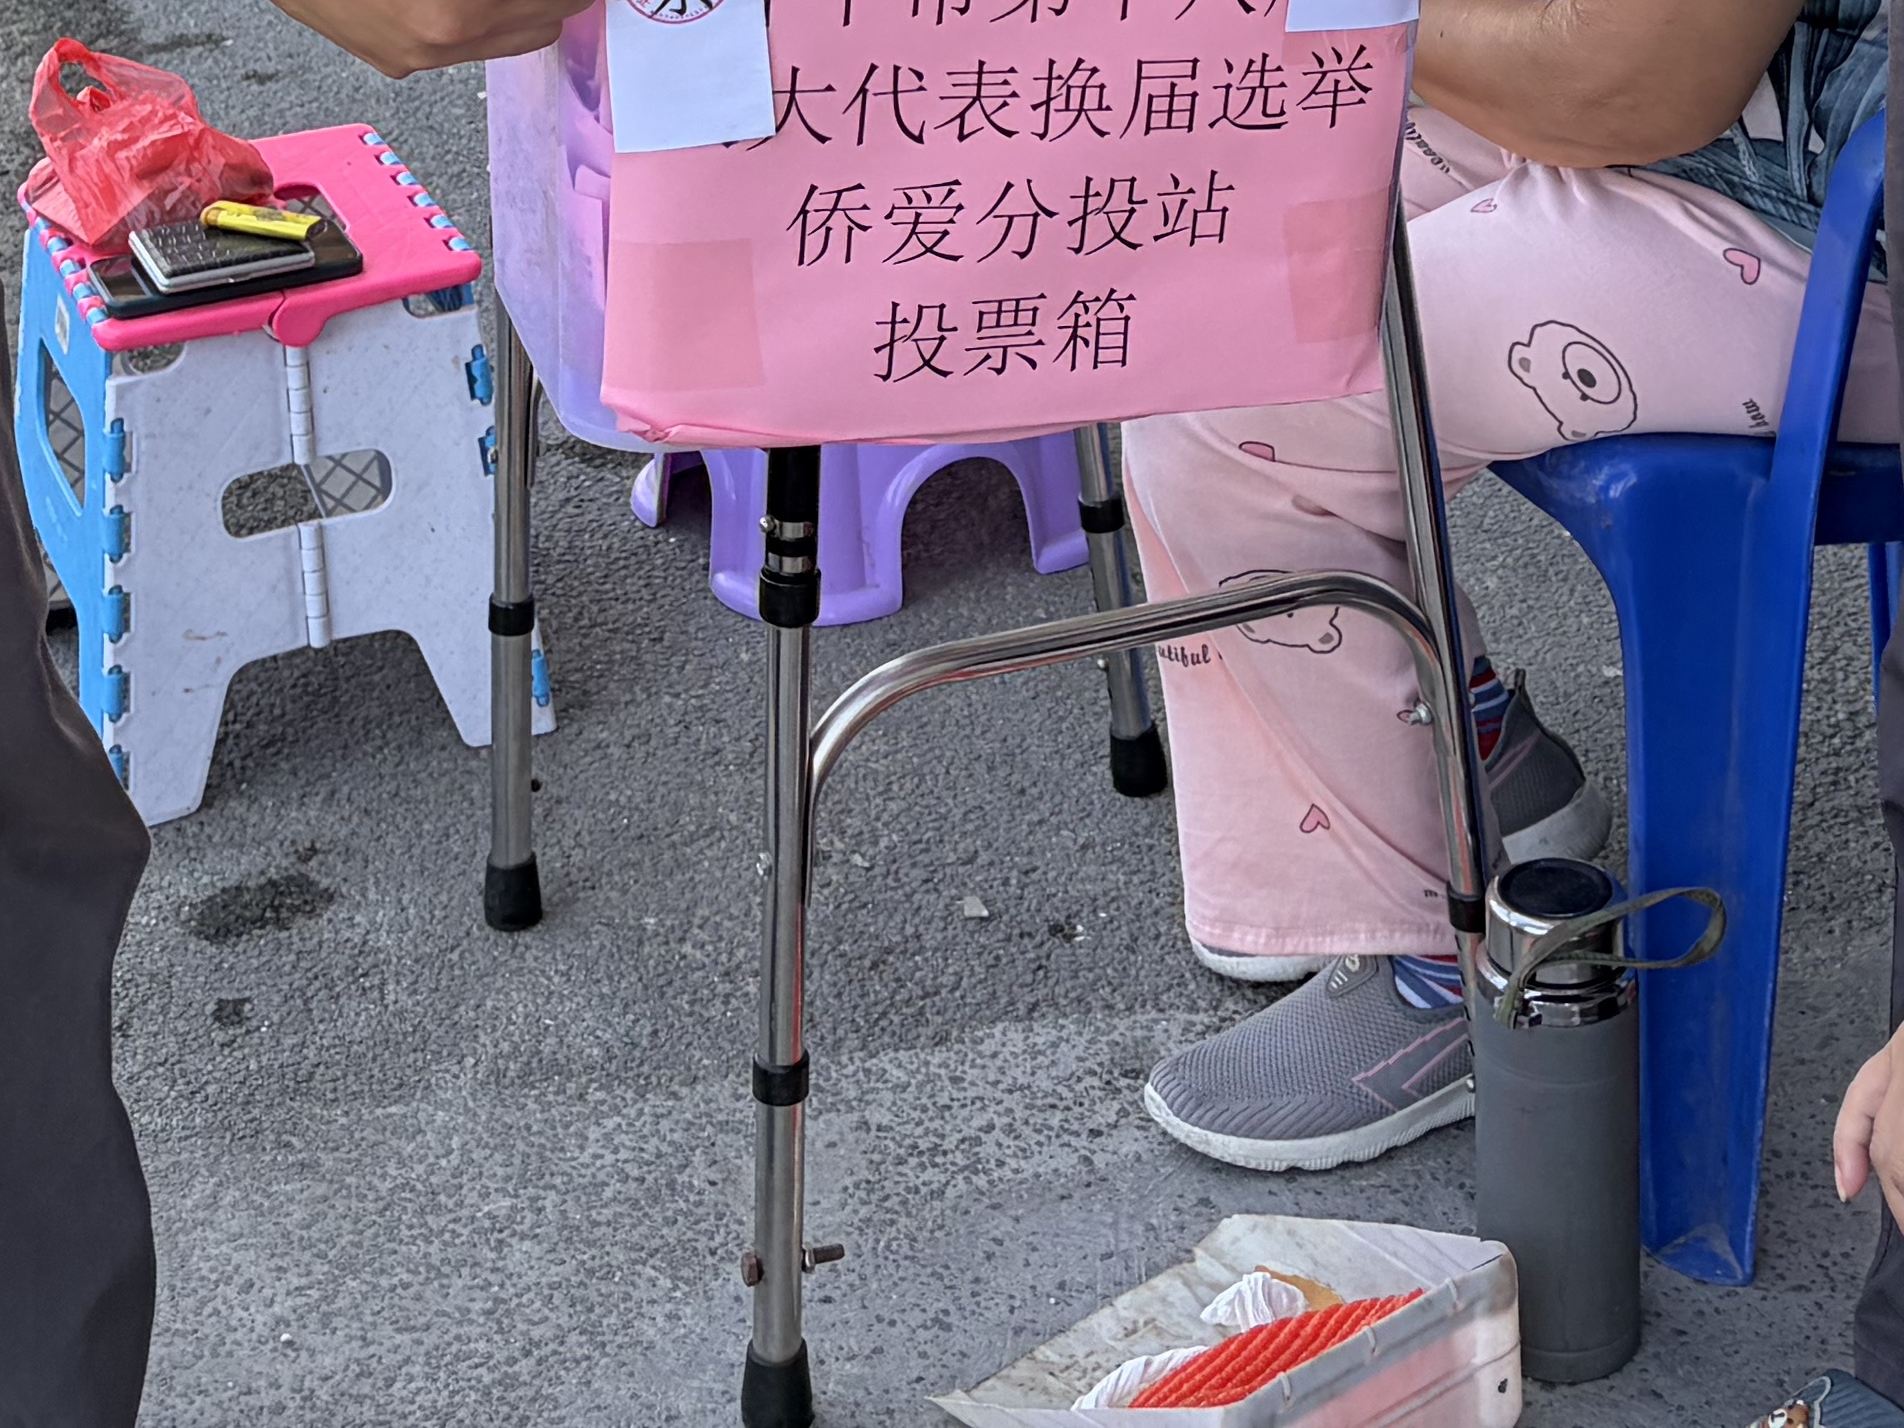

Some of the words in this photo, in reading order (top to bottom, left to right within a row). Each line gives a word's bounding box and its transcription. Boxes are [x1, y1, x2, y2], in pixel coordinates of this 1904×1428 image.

[724, 44, 1375, 150] 大代表换届选举
[784, 170, 1235, 268] 侨爱分投站
[873, 290, 1140, 385] 投票箱
[1157, 643, 1212, 668] utiful
